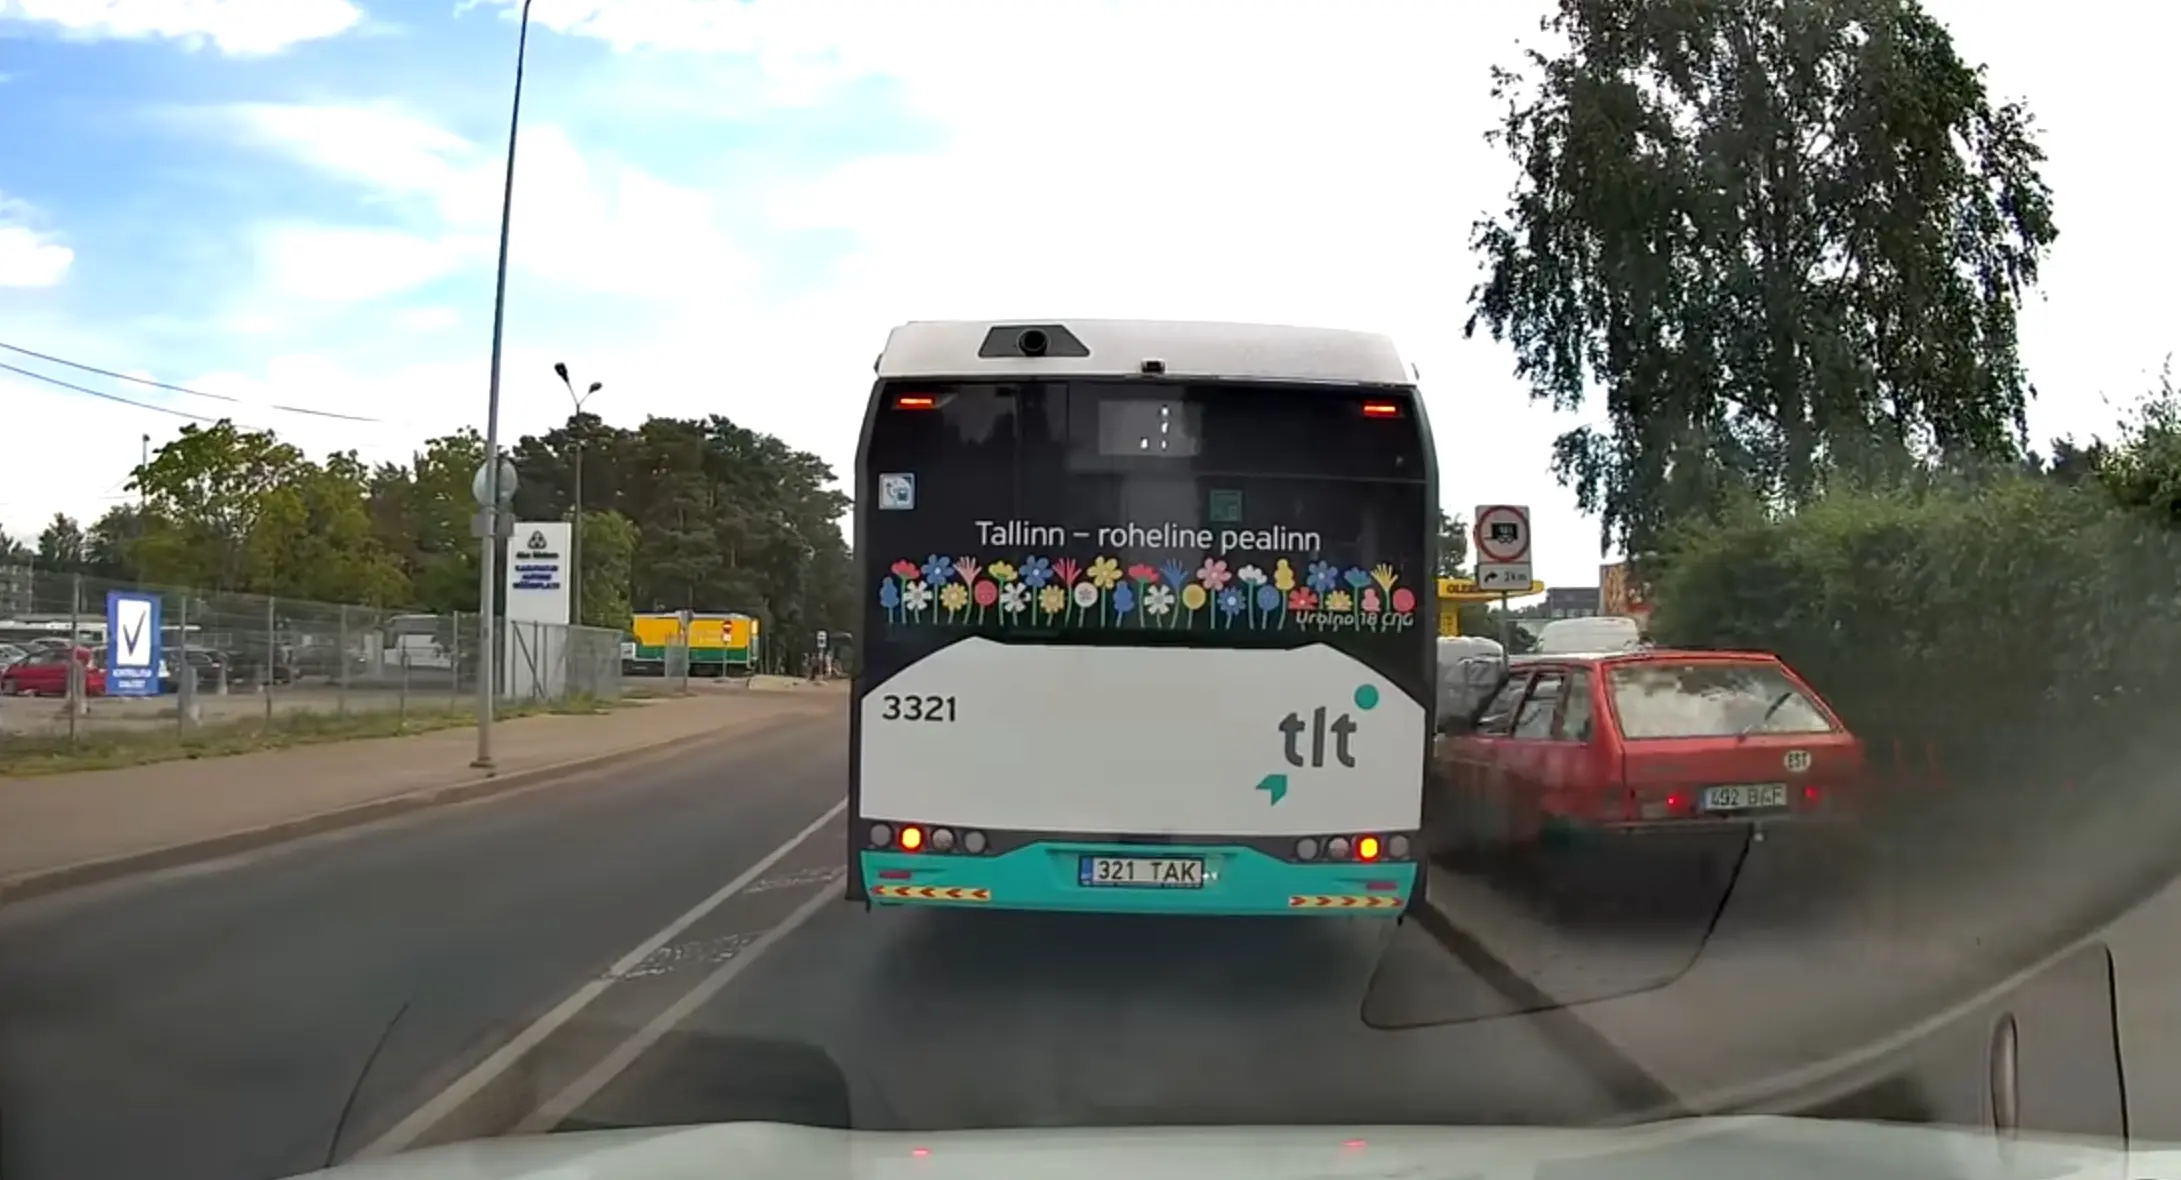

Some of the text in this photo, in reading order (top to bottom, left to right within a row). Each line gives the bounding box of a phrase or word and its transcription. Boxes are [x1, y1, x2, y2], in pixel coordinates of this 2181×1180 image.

[974, 520, 1065, 547] Tallinn
[1099, 522, 1214, 549] roheline
[1221, 526, 1321, 555] pealinn
[1295, 610, 1354, 626] Urbino
[1360, 610, 1378, 626] 18
[882, 694, 957, 722] 3321
[1278, 706, 1357, 767] tlt
[1789, 751, 1808, 769] EST
[1098, 860, 1196, 882] 321 TAK
